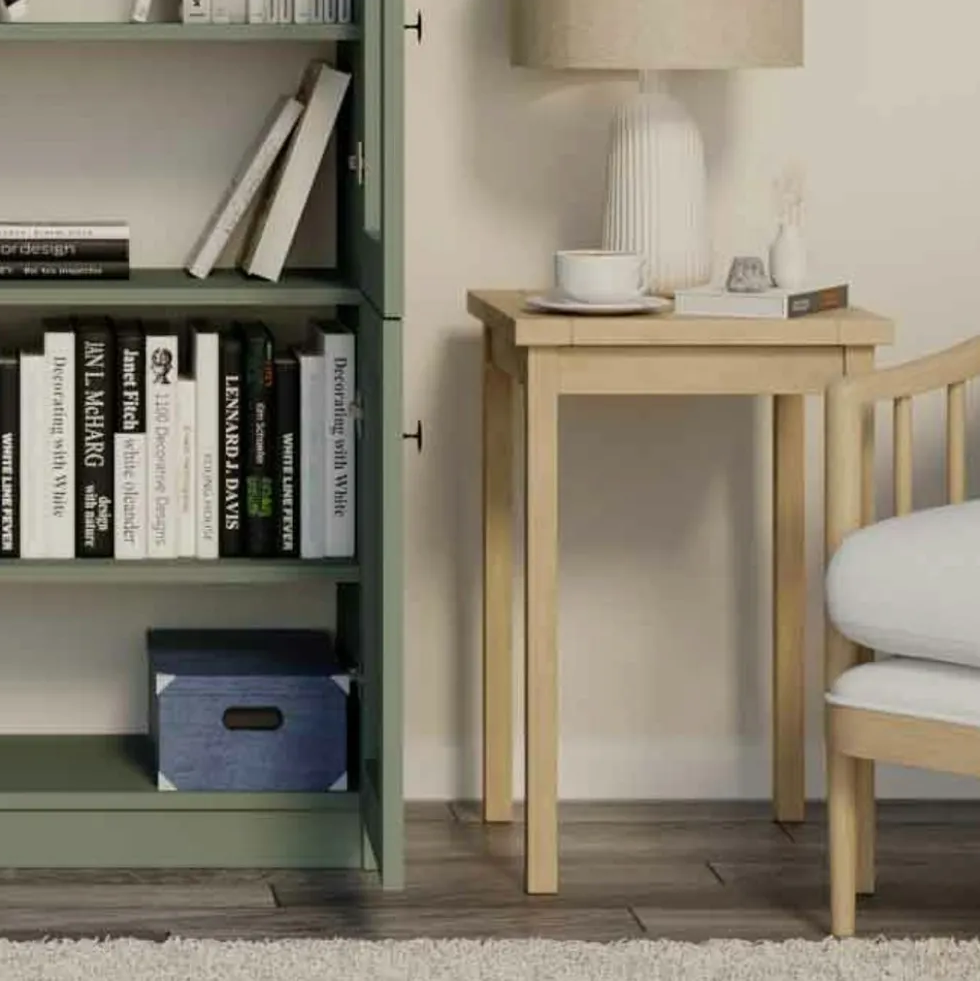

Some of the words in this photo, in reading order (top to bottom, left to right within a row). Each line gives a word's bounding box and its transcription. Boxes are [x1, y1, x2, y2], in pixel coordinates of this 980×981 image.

[123, 348, 139, 386] Janet
[50, 356, 67, 435] Decorating
[123, 390, 139, 430] Fitch
[225, 375, 239, 457] LENNARD
[331, 356, 348, 435] Decorating
[84, 390, 105, 468] McHARG
[1, 432, 12, 474] WHITE
[52, 438, 67, 470] with
[123, 438, 139, 479] white
[282, 432, 293, 474] WHITE
[334, 438, 348, 470] with
[1, 476, 12, 506] LINE
[52, 475, 67, 518] White
[84, 484, 97, 508] with
[225, 478, 239, 530] DAVIS
[282, 476, 293, 506] LINE
[334, 475, 348, 518] White
[1, 508, 12, 551] FEVER
[98, 496, 111, 531] design
[282, 508, 293, 551] FEVER
